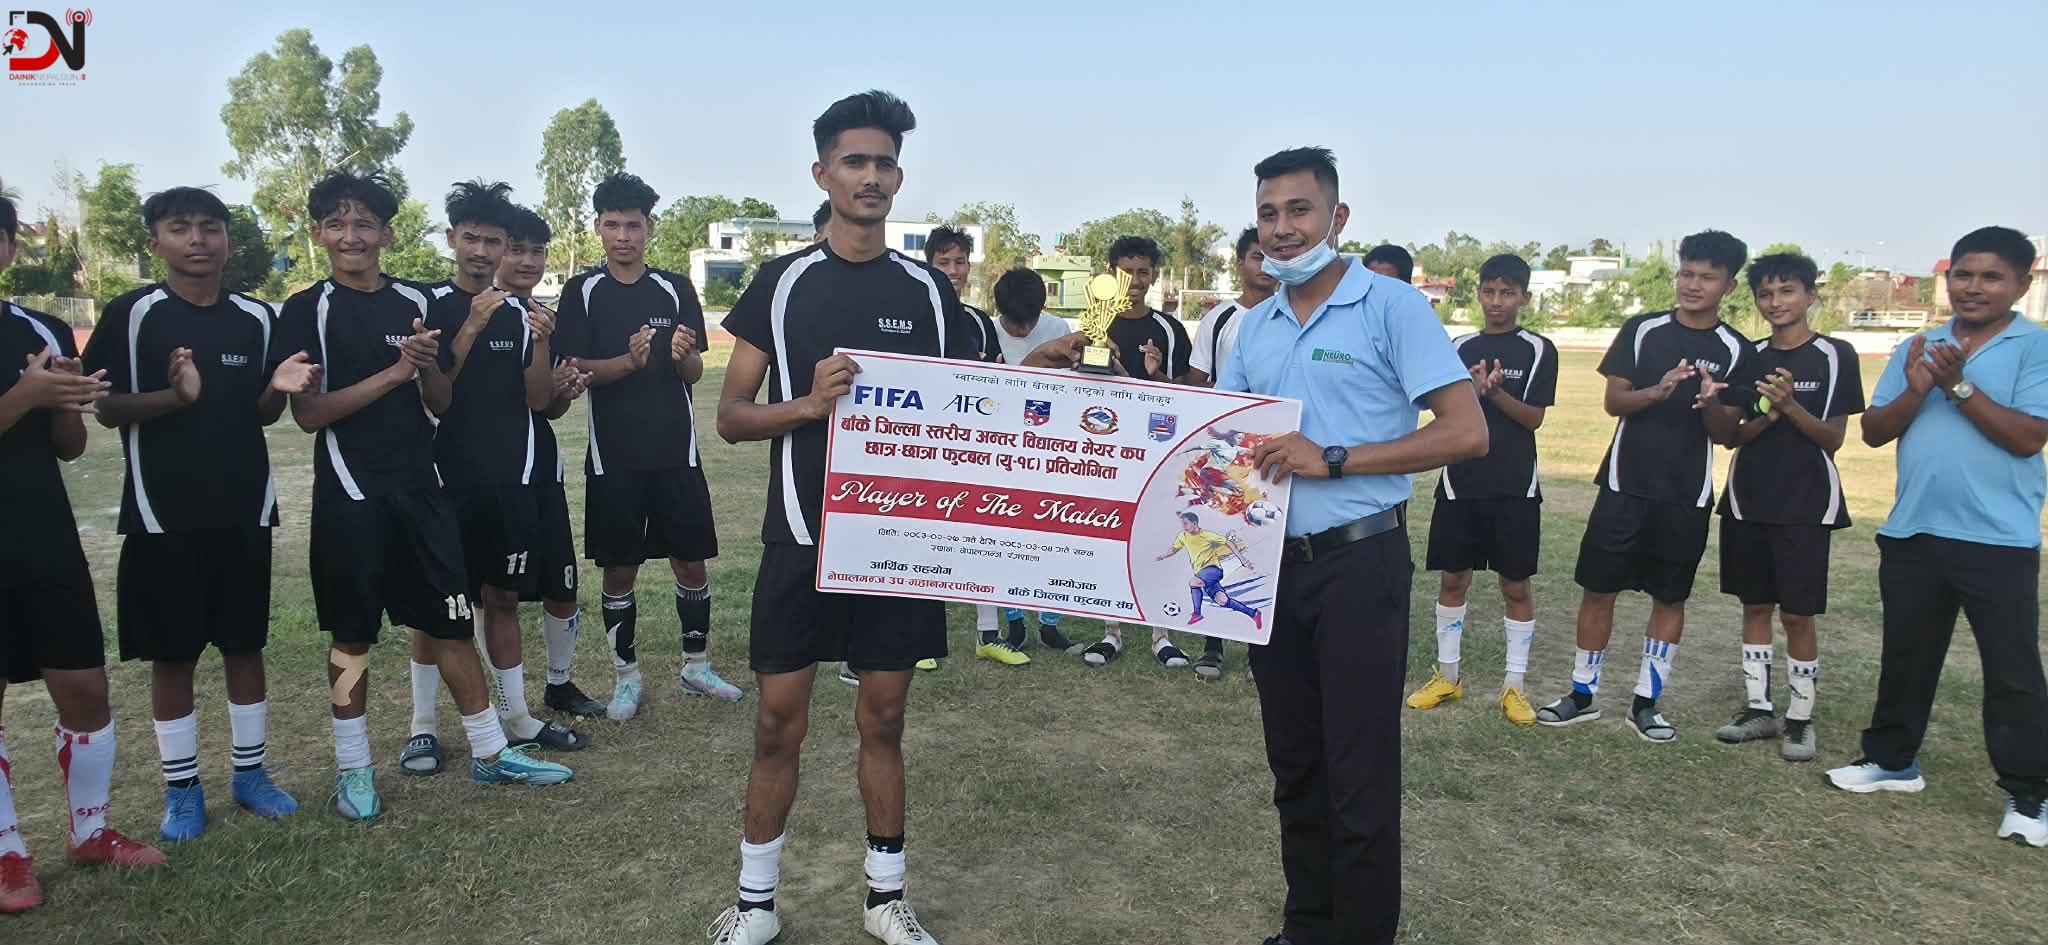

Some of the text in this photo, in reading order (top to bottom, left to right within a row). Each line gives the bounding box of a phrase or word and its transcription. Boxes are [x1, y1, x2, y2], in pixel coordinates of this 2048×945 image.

[854, 385, 924, 411] FIFA
[1005, 377, 1027, 389] लागि
[1110, 389, 1133, 400] लागि
[942, 394, 994, 416] AFC
[874, 415, 921, 437] जिल्ला
[926, 423, 973, 442] स्तरीय
[976, 429, 1019, 447] अन्तर
[1022, 430, 1079, 453] विद्यालय
[1082, 437, 1117, 458] मेयर
[1120, 446, 1146, 461] कप
[942, 447, 992, 466] फुटबल
[1045, 456, 1119, 479] प्रतियोगिता
[831, 480, 1124, 529] Player of The Match
[506, 550, 528, 575] 11
[870, 560, 953, 576] आर्थिक सहयोग
[564, 565, 574, 590] 8
[1048, 577, 1098, 591] आयोजक
[444, 593, 471, 620] 14
[1033, 588, 1070, 602] जिल्ला
[1073, 594, 1112, 607] फुटबल
[1115, 599, 1134, 610] संघ
